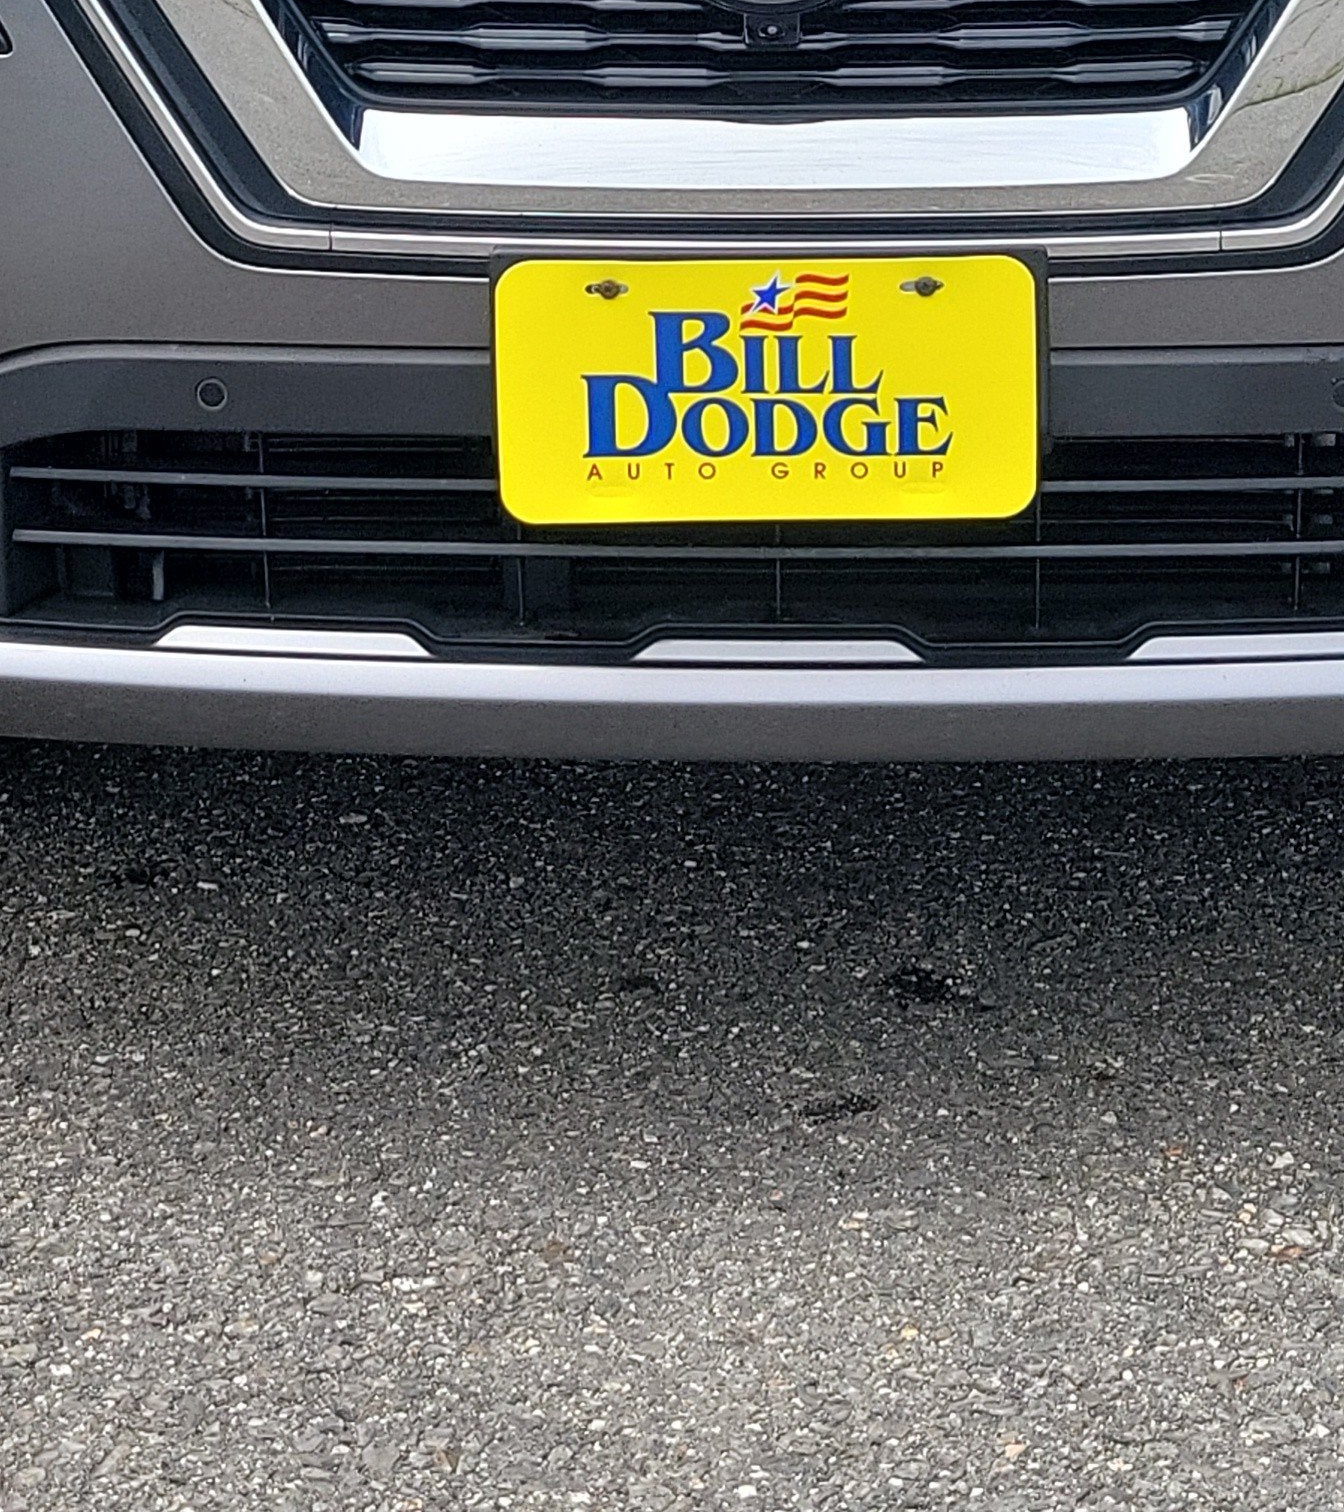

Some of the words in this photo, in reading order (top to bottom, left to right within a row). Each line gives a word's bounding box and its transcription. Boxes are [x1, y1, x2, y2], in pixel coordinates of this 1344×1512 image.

[648, 310, 884, 395] BILL
[581, 374, 954, 458] DODGE
[586, 461, 717, 481] AUTO
[771, 461, 945, 481] GROUP
